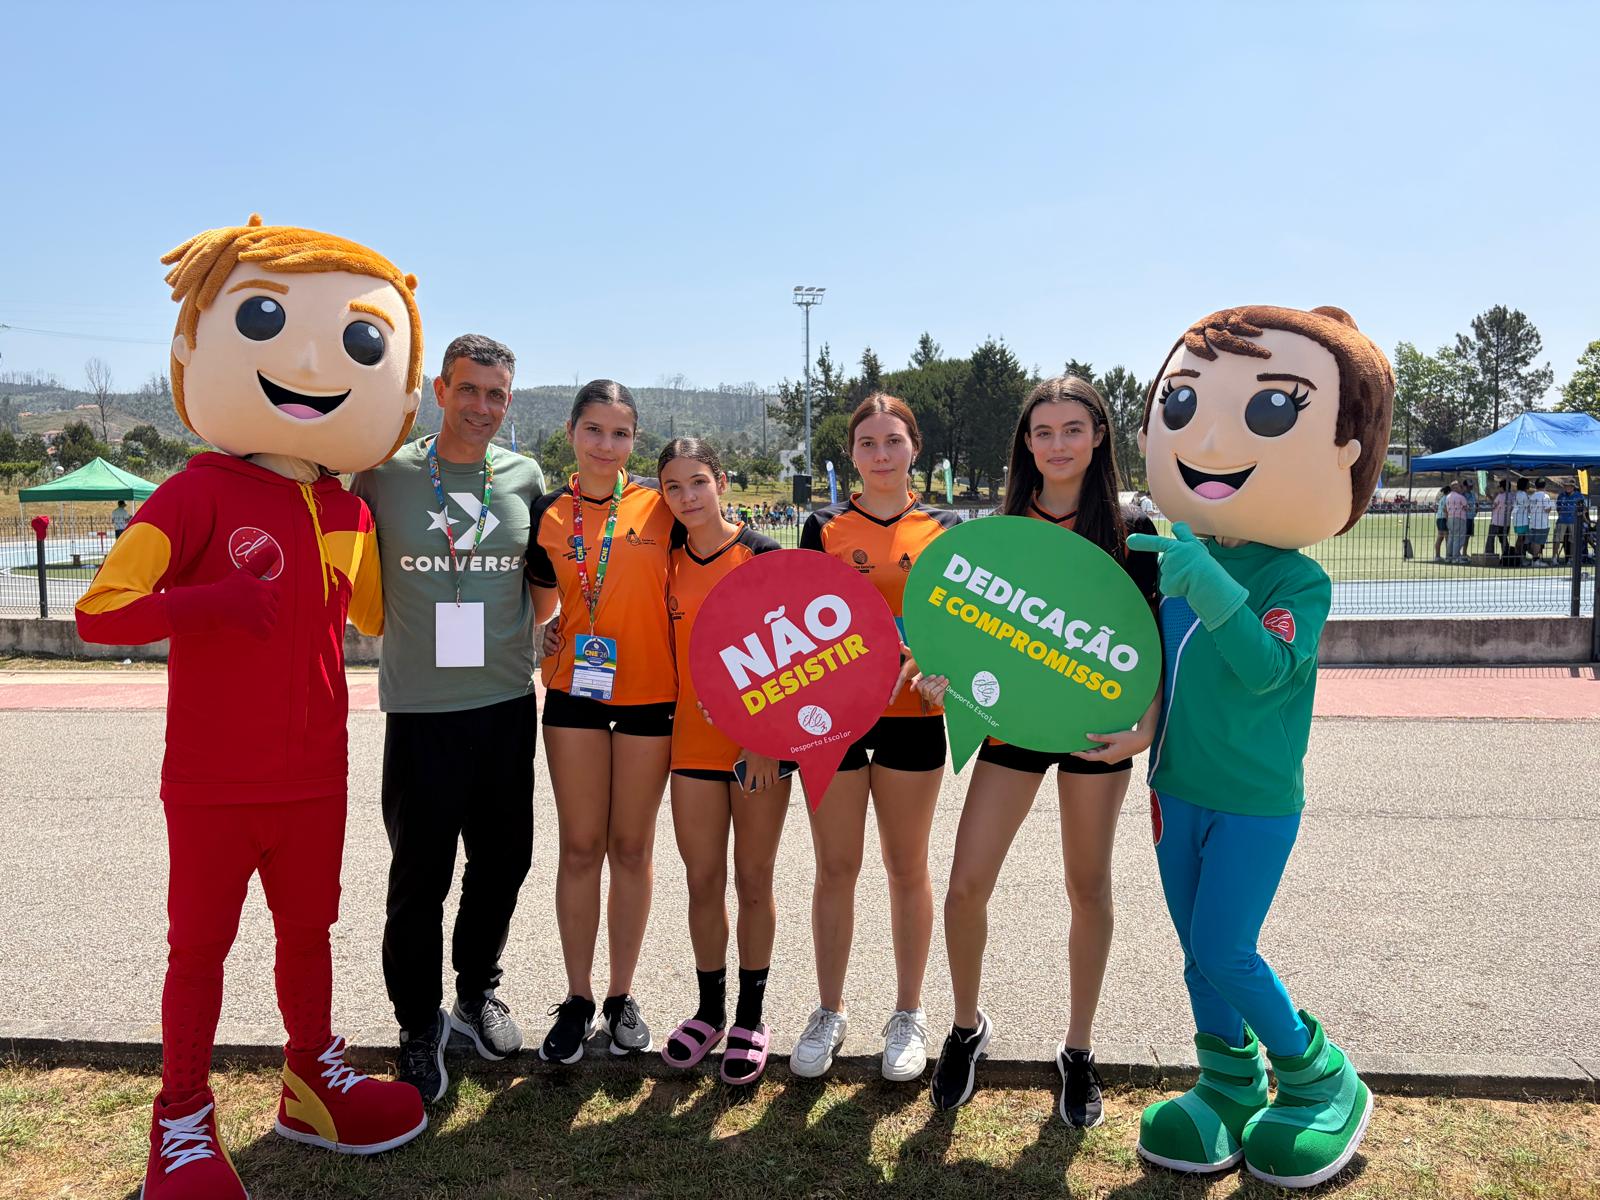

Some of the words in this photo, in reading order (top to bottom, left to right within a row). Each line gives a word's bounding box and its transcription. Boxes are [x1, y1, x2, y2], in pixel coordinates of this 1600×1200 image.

[400, 555, 520, 572] CONVERSE
[601, 547, 609, 561] CNE
[718, 594, 852, 691] NÃO
[928, 585, 947, 607] E
[946, 596, 1122, 700] COMPROMISSO
[943, 553, 1139, 672] DEDICAÇÃO
[741, 633, 870, 716] DESISTIR
[945, 685, 974, 709] Desporto
[973, 706, 1000, 728] Escolar
[790, 739, 823, 754] Desporto
[823, 730, 852, 744] Escolar
